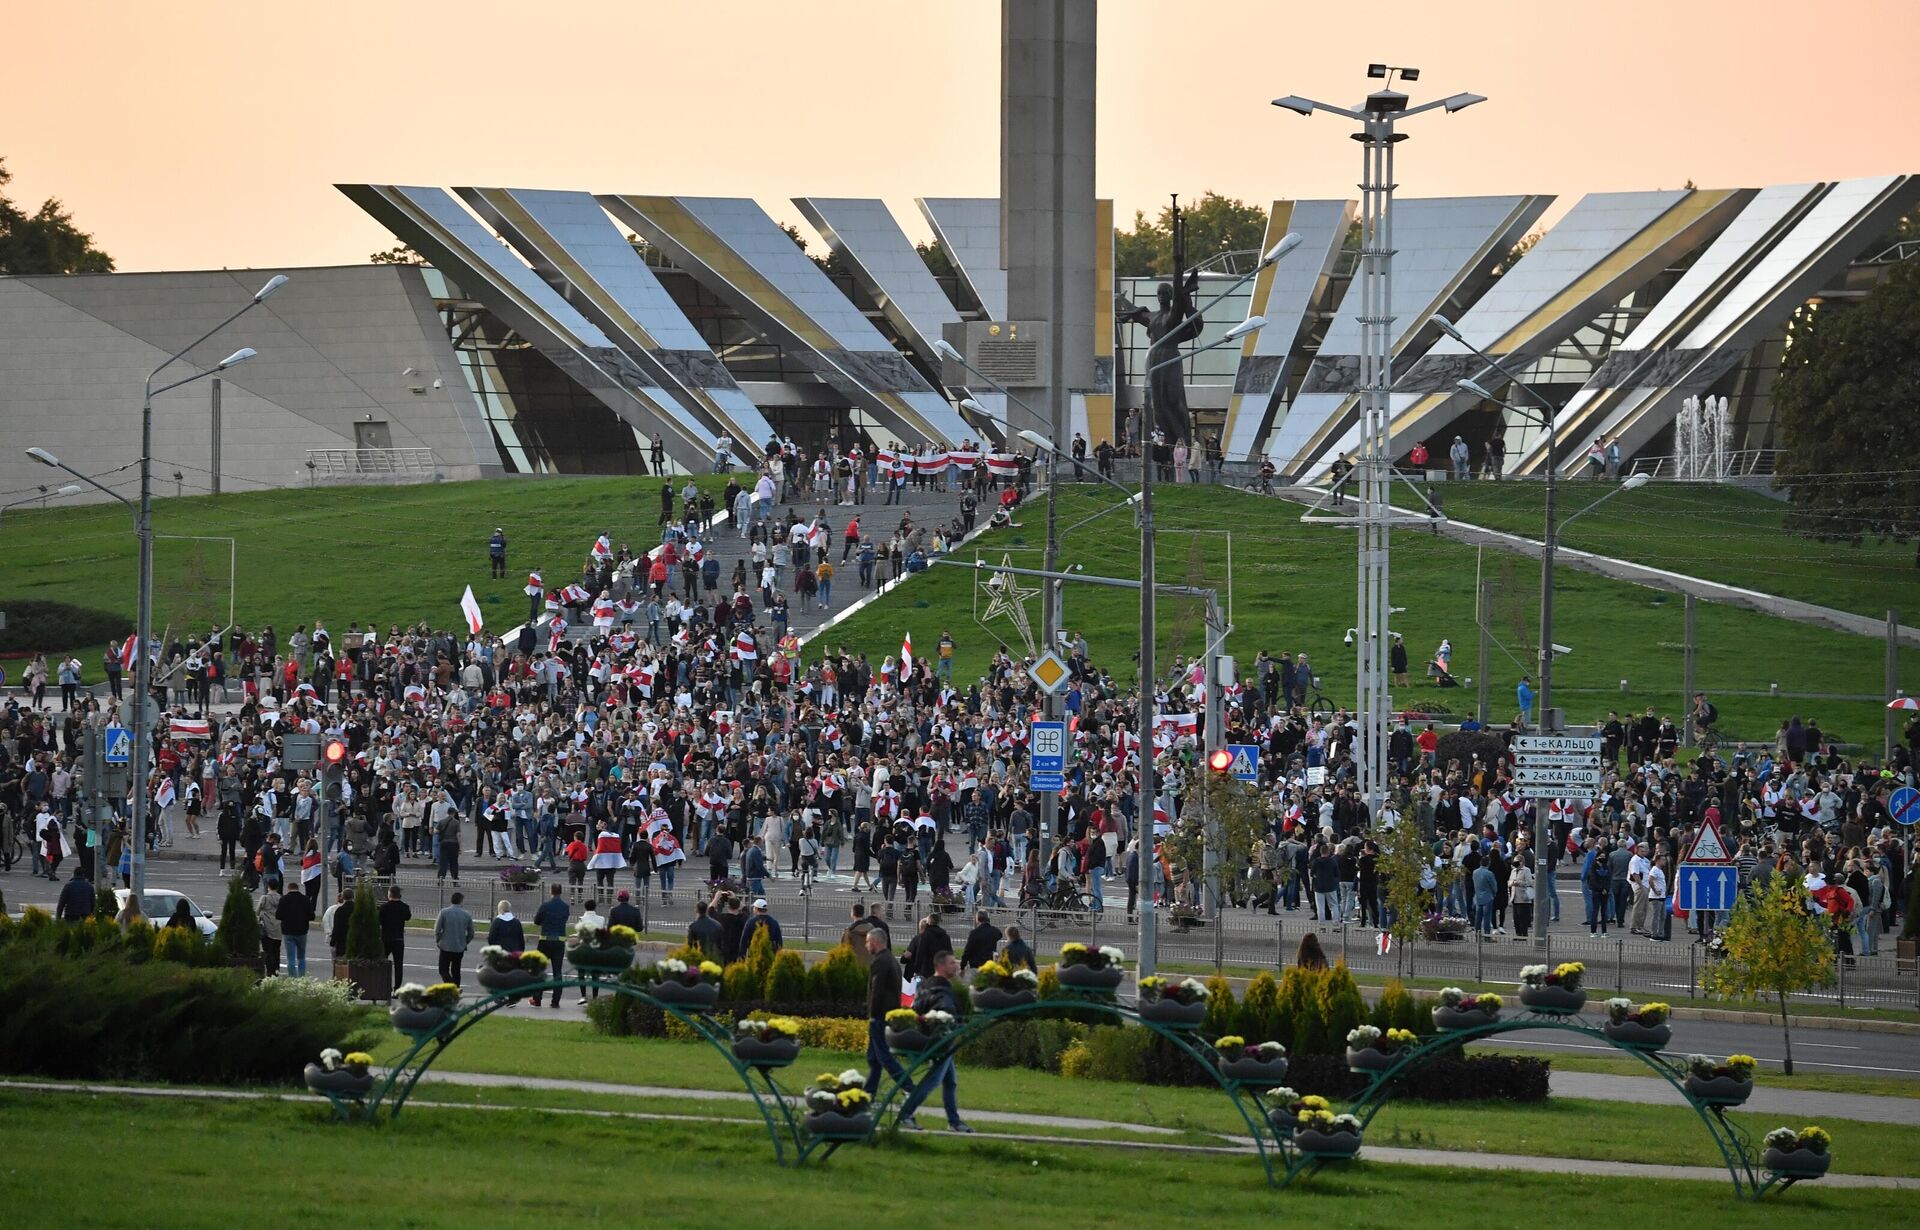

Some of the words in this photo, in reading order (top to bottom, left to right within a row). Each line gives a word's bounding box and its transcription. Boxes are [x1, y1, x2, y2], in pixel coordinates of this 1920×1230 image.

[1534, 739, 1547, 748] 1-е
[1549, 739, 1594, 750] КАЛЬЦО
[1533, 772, 1547, 780] 2-е
[1549, 772, 1593, 782] КАЛЬЦО
